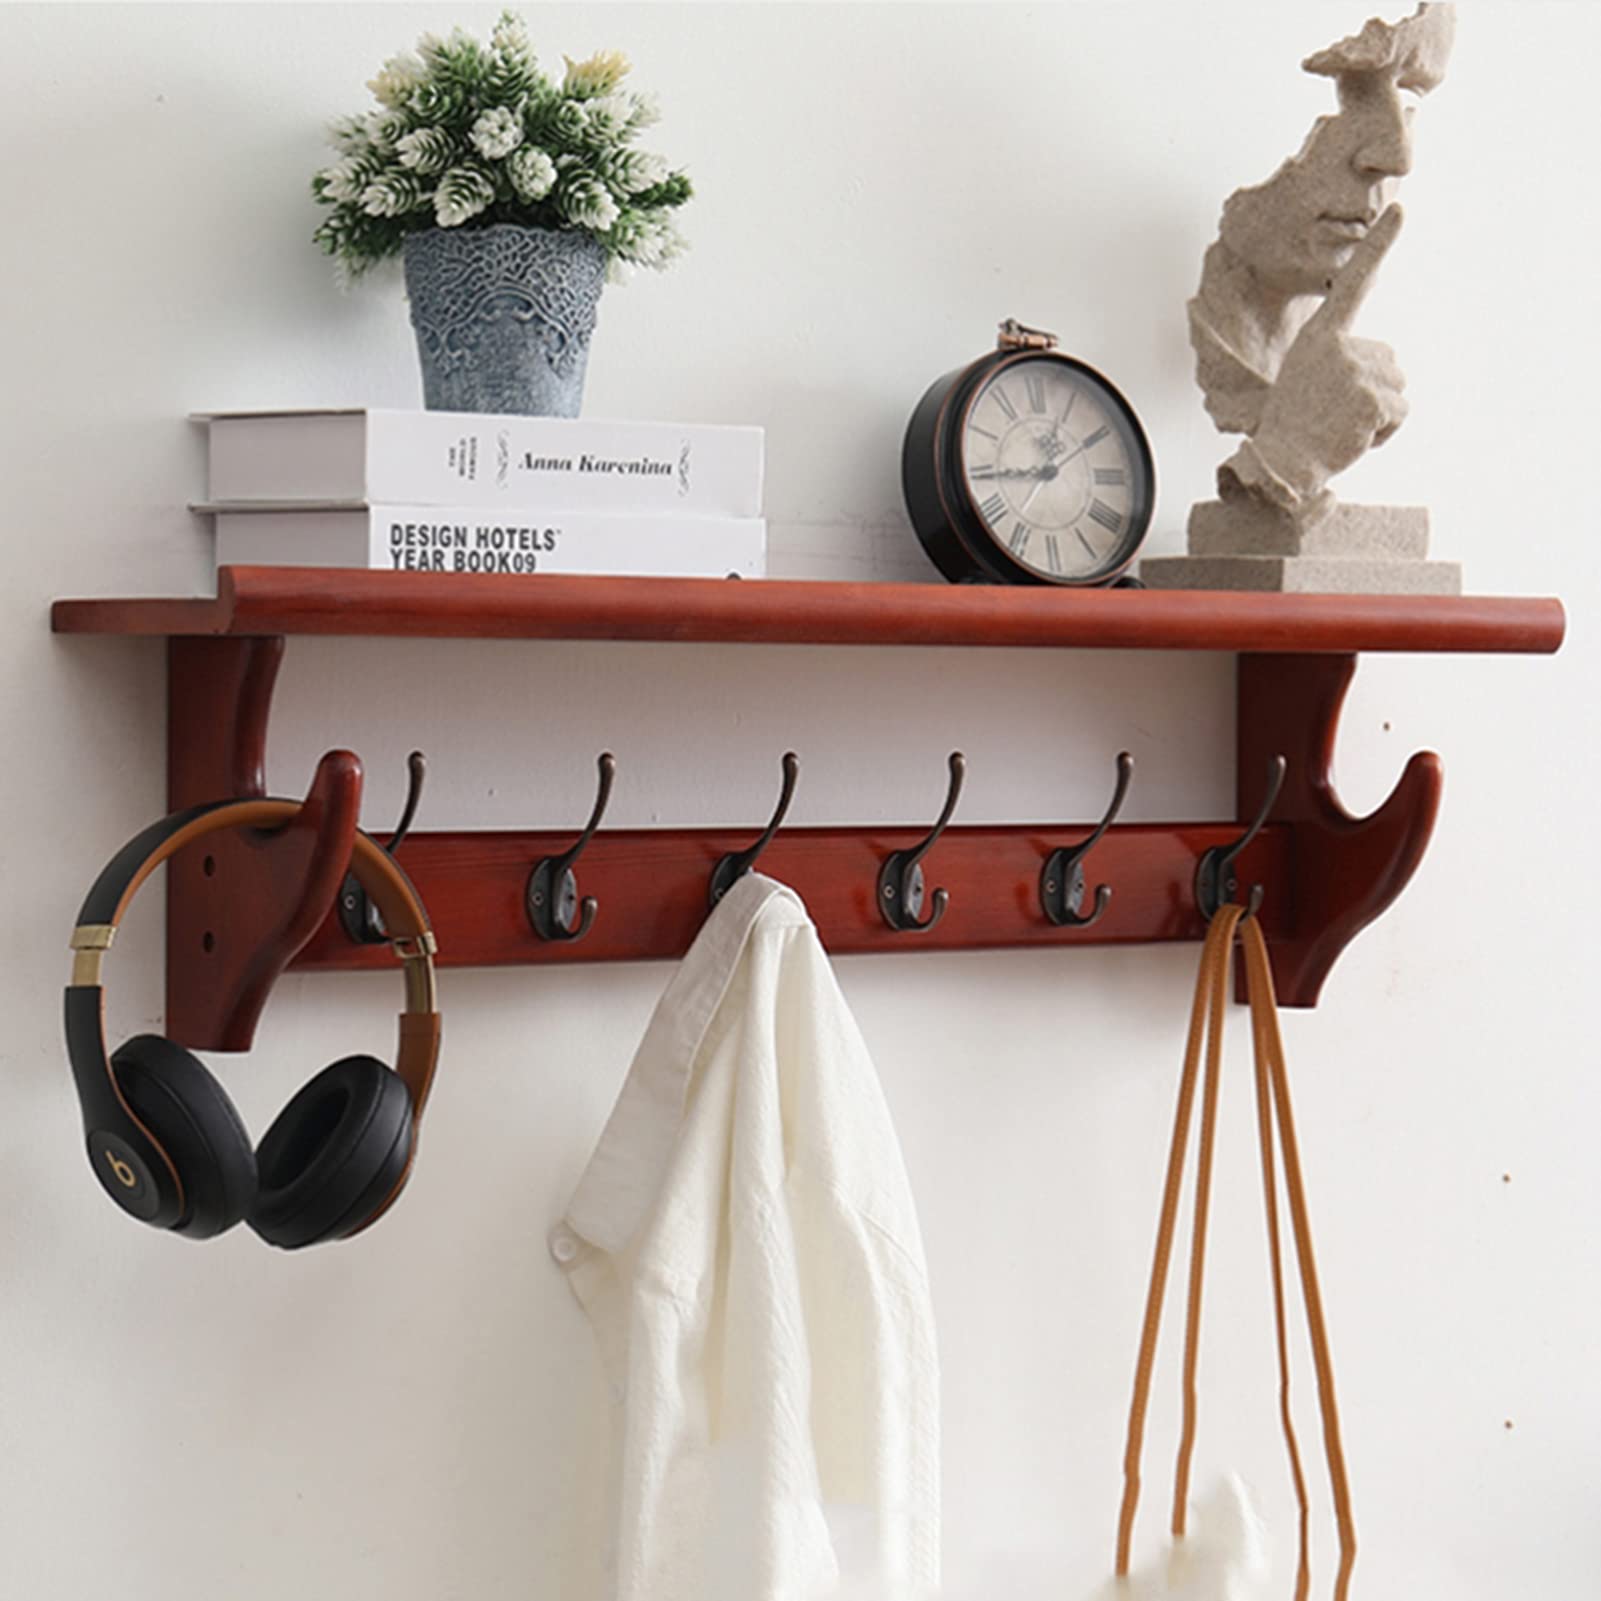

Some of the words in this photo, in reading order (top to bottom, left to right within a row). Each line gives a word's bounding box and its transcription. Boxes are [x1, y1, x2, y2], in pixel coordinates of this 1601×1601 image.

[518, 452, 573, 472] Anna
[577, 453, 673, 476] Karenina
[390, 524, 468, 548] DESIGN
[475, 527, 556, 552] HOTELS
[390, 548, 446, 571] YEAR
[453, 550, 537, 573] BOOK09
